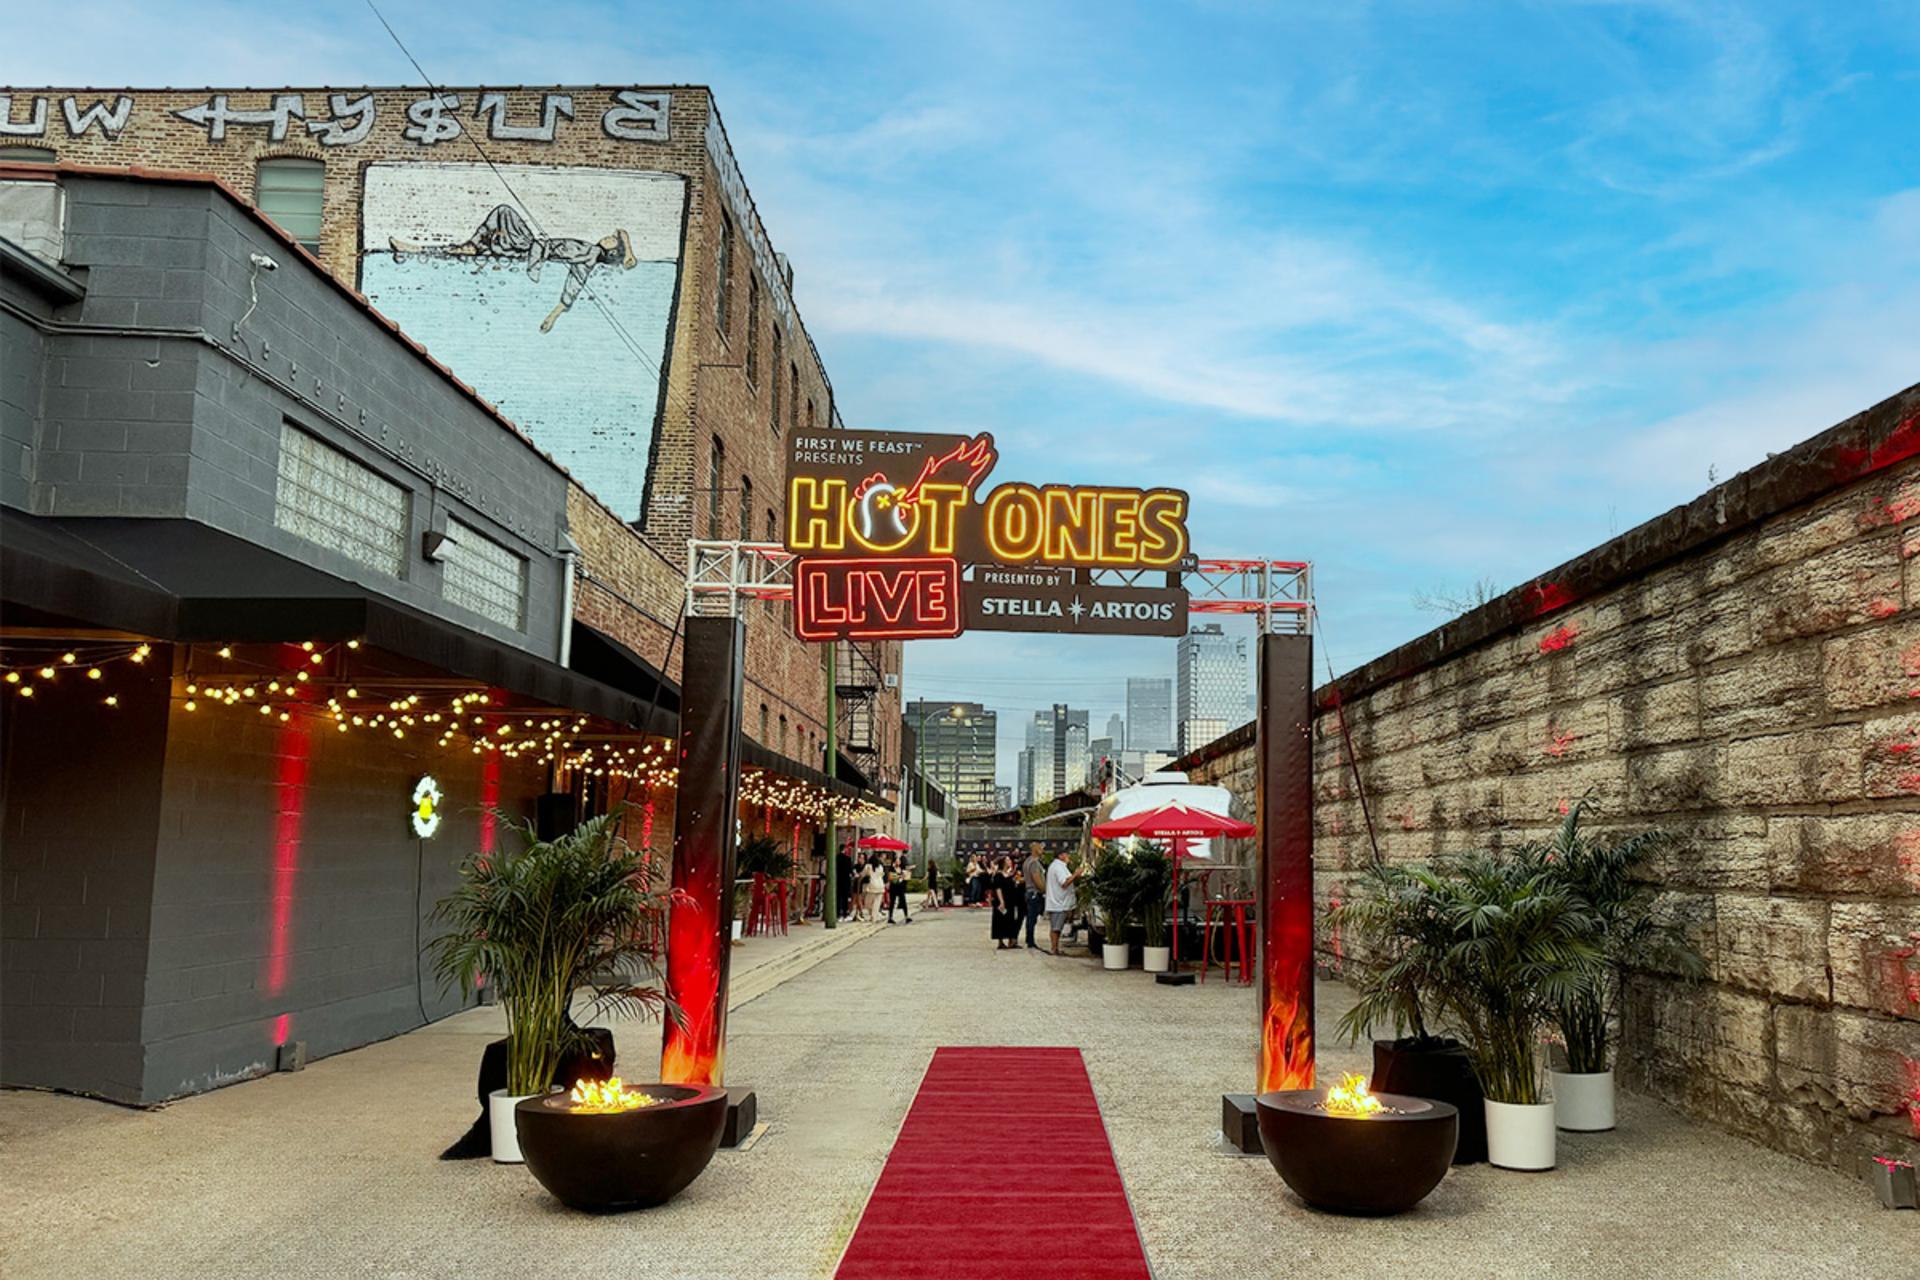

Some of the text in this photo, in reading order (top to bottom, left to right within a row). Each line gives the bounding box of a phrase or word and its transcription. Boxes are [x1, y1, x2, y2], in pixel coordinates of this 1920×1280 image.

[796, 437, 837, 451] FIRST
[841, 439, 864, 452] WE
[795, 451, 864, 465] PRESENTS
[790, 477, 969, 554] HOT
[984, 572, 1061, 587] PRESENTED BY
[808, 569, 948, 624] LIVE
[981, 597, 1176, 621] STELLA ARTOIS
